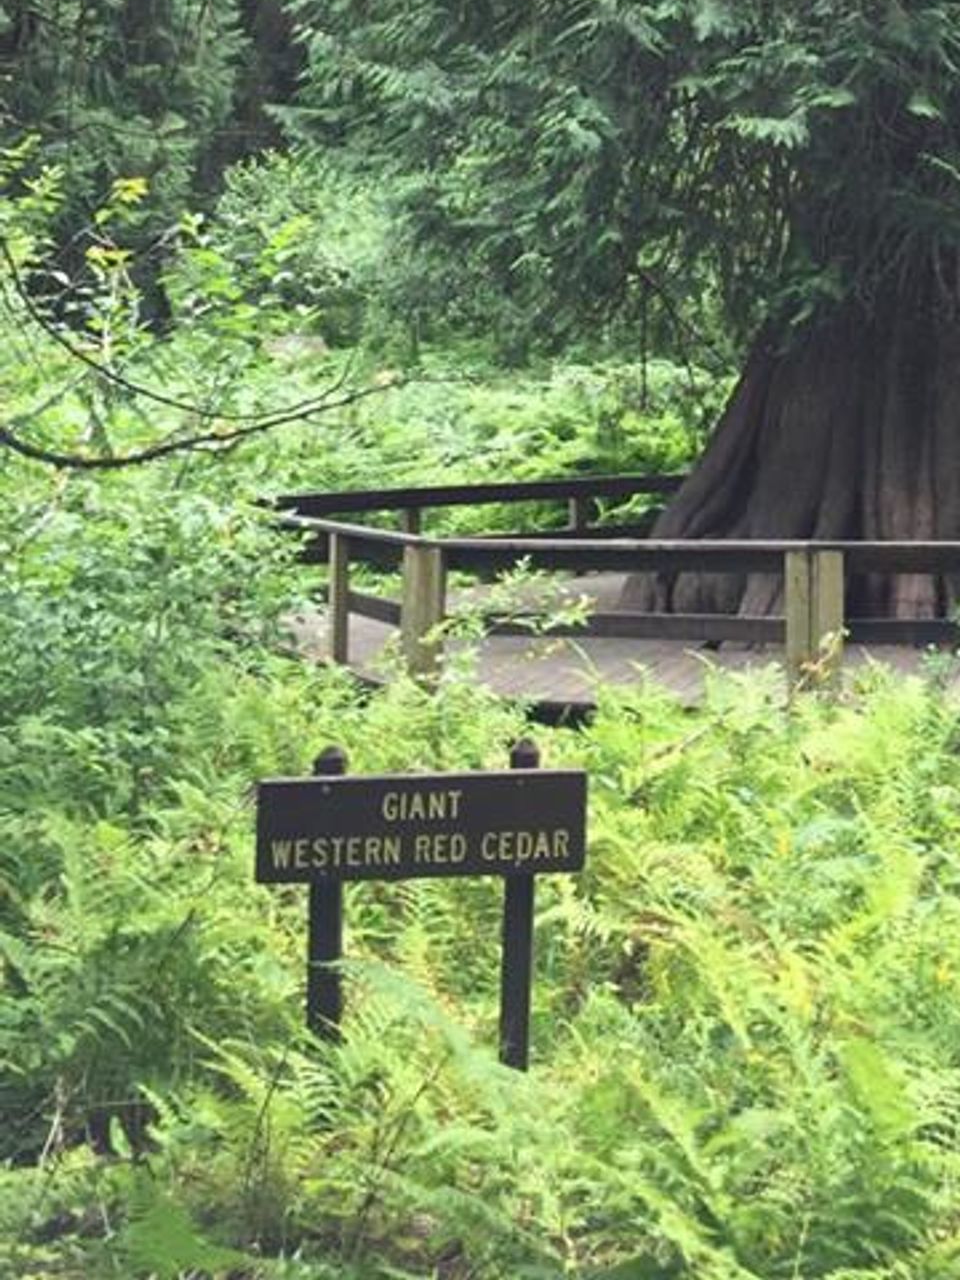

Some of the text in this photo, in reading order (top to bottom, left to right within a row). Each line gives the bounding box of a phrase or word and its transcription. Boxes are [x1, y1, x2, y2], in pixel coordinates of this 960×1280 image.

[382, 790, 463, 821] GIANT
[271, 829, 570, 869] WESTERN RED CEDAR
